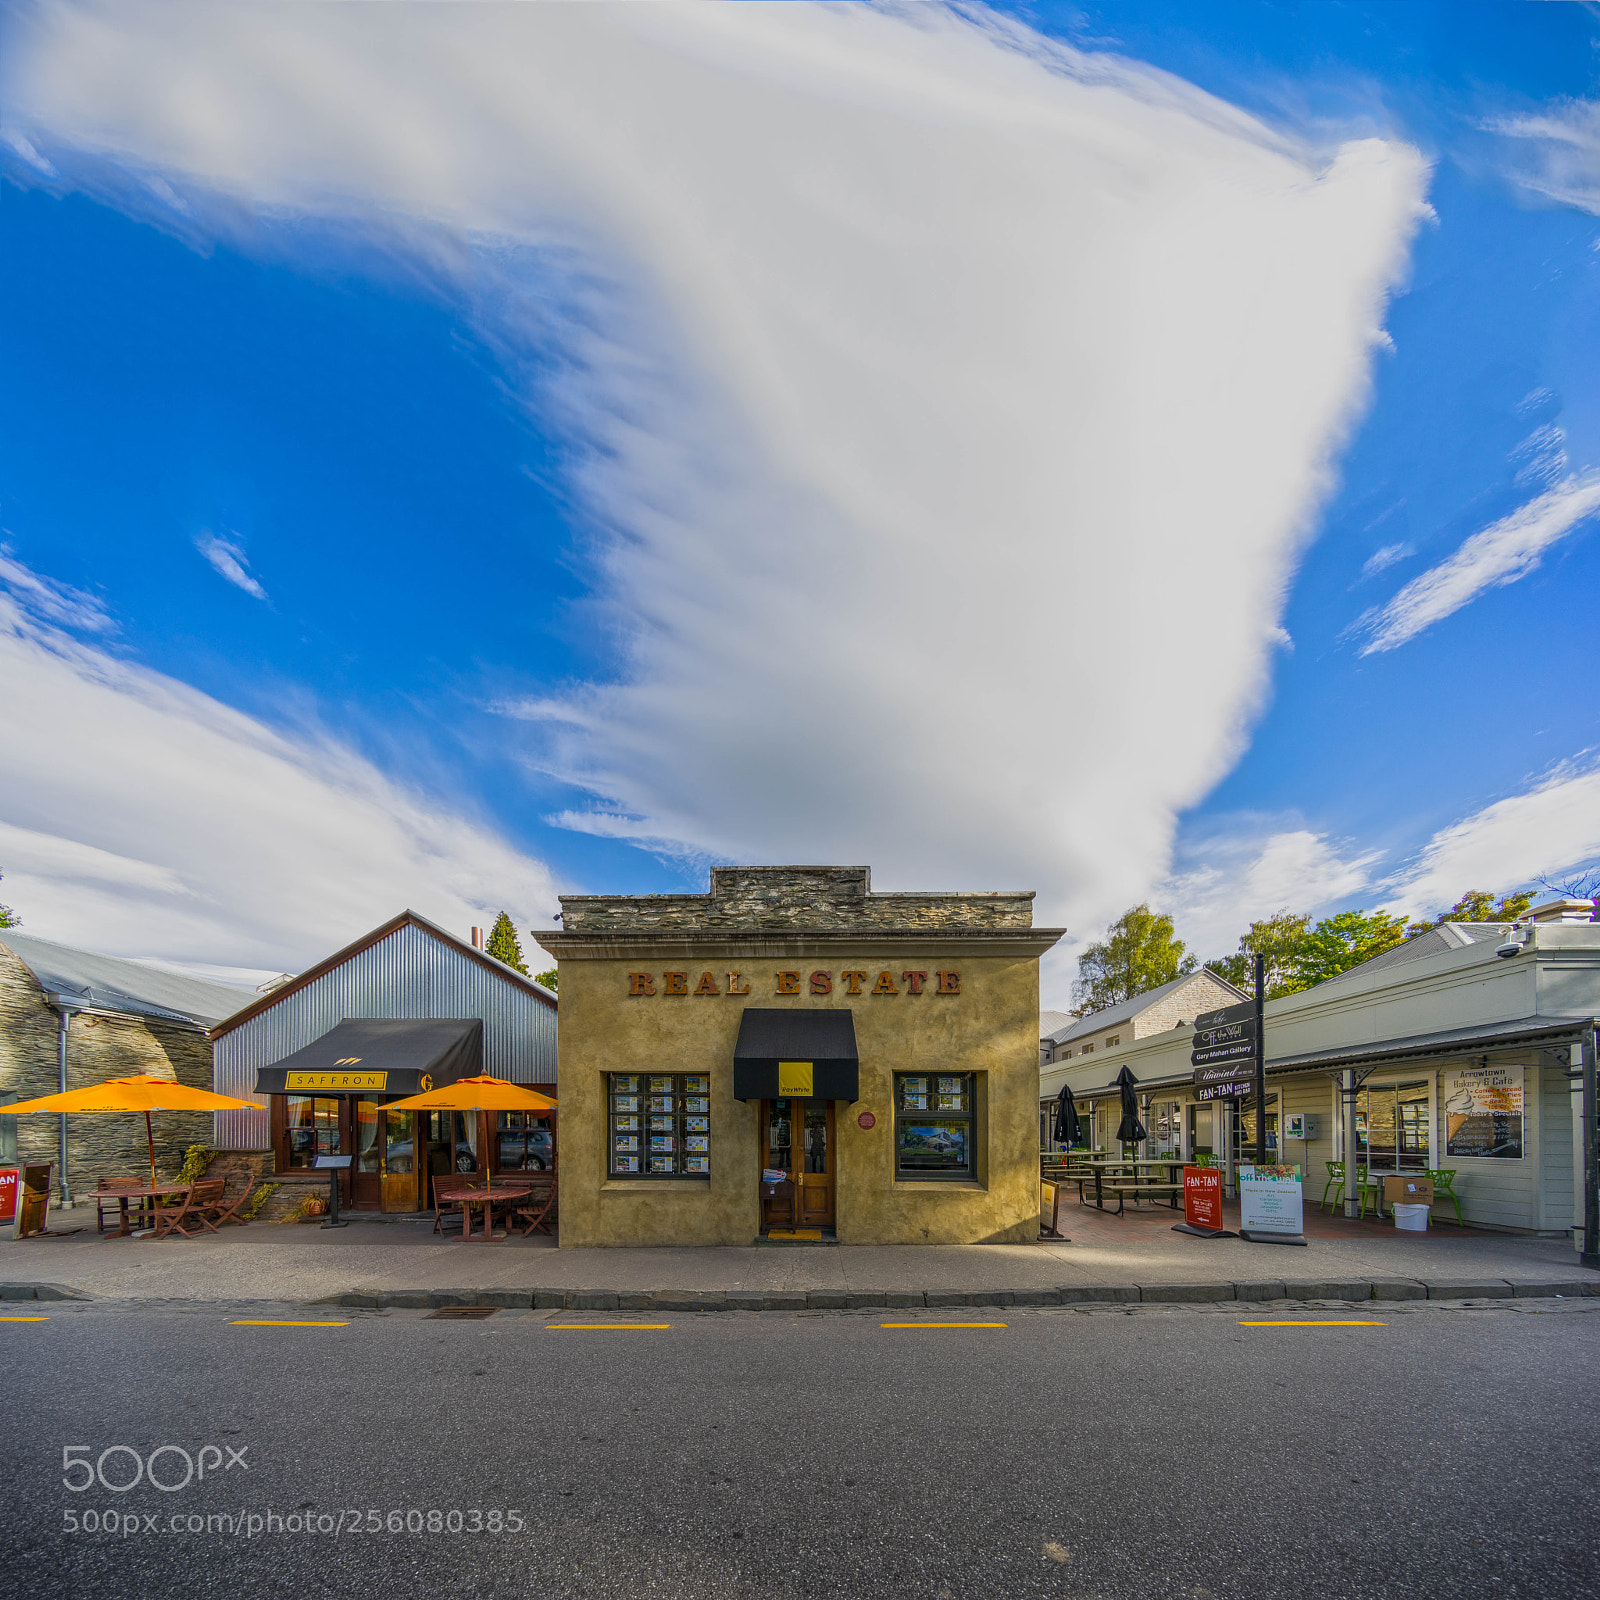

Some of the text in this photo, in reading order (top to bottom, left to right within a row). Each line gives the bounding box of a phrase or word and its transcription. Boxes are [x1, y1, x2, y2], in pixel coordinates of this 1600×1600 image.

[628, 970, 962, 995] REAL ESTATE
[1201, 1024, 1242, 1046] Off the Wall
[1229, 1045, 1252, 1055] Gallery
[1198, 1064, 1240, 1080] Unwind
[1460, 1069, 1506, 1078] Arrowtown
[296, 1076, 376, 1085] SAFFRON
[1453, 1076, 1513, 1088] Bakery & Café
[1199, 1082, 1233, 1101] FAN-TAN
[1242, 1087, 1251, 1095] BAR
[1186, 1176, 1218, 1187] FAN-TAN
[1240, 1172, 1254, 1182] off
